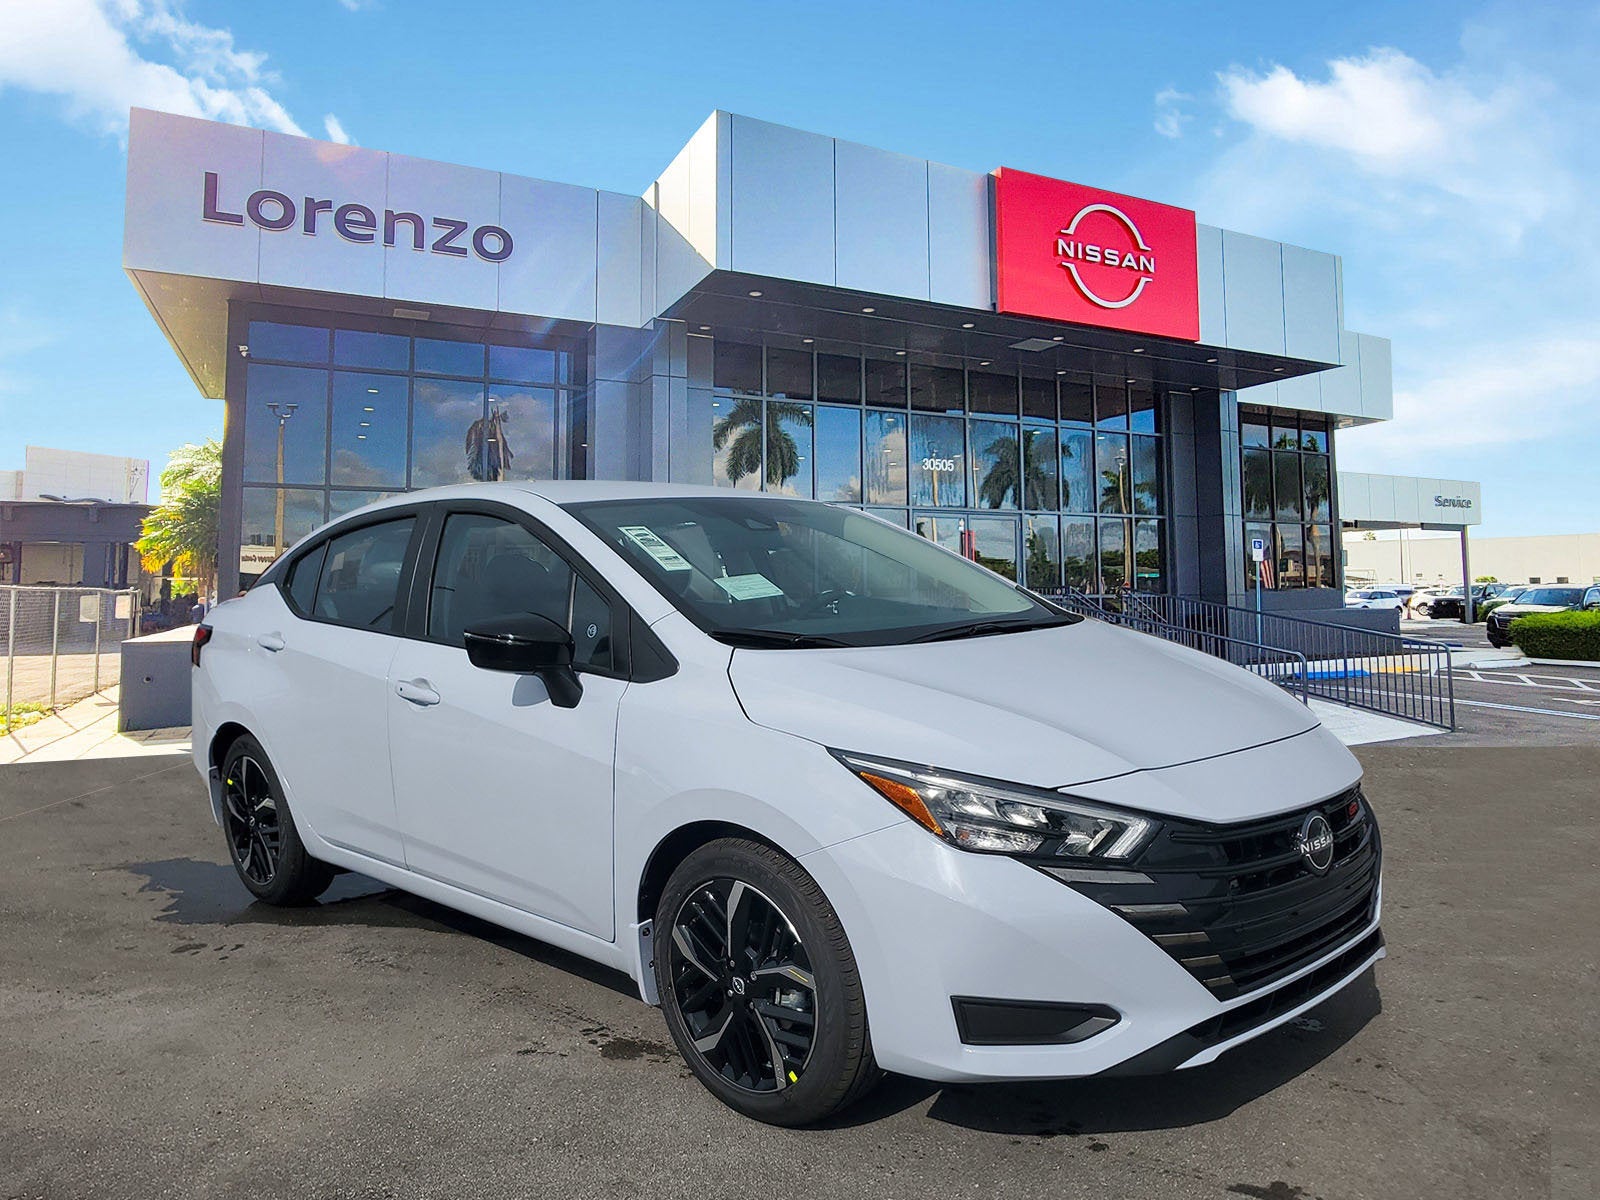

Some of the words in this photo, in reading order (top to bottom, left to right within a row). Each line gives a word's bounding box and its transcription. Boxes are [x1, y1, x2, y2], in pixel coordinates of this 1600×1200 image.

[202, 171, 514, 262] Lorenzo
[1057, 238, 1155, 273] NISSAN
[922, 457, 954, 472] 30505
[1434, 495, 1472, 509] Service
